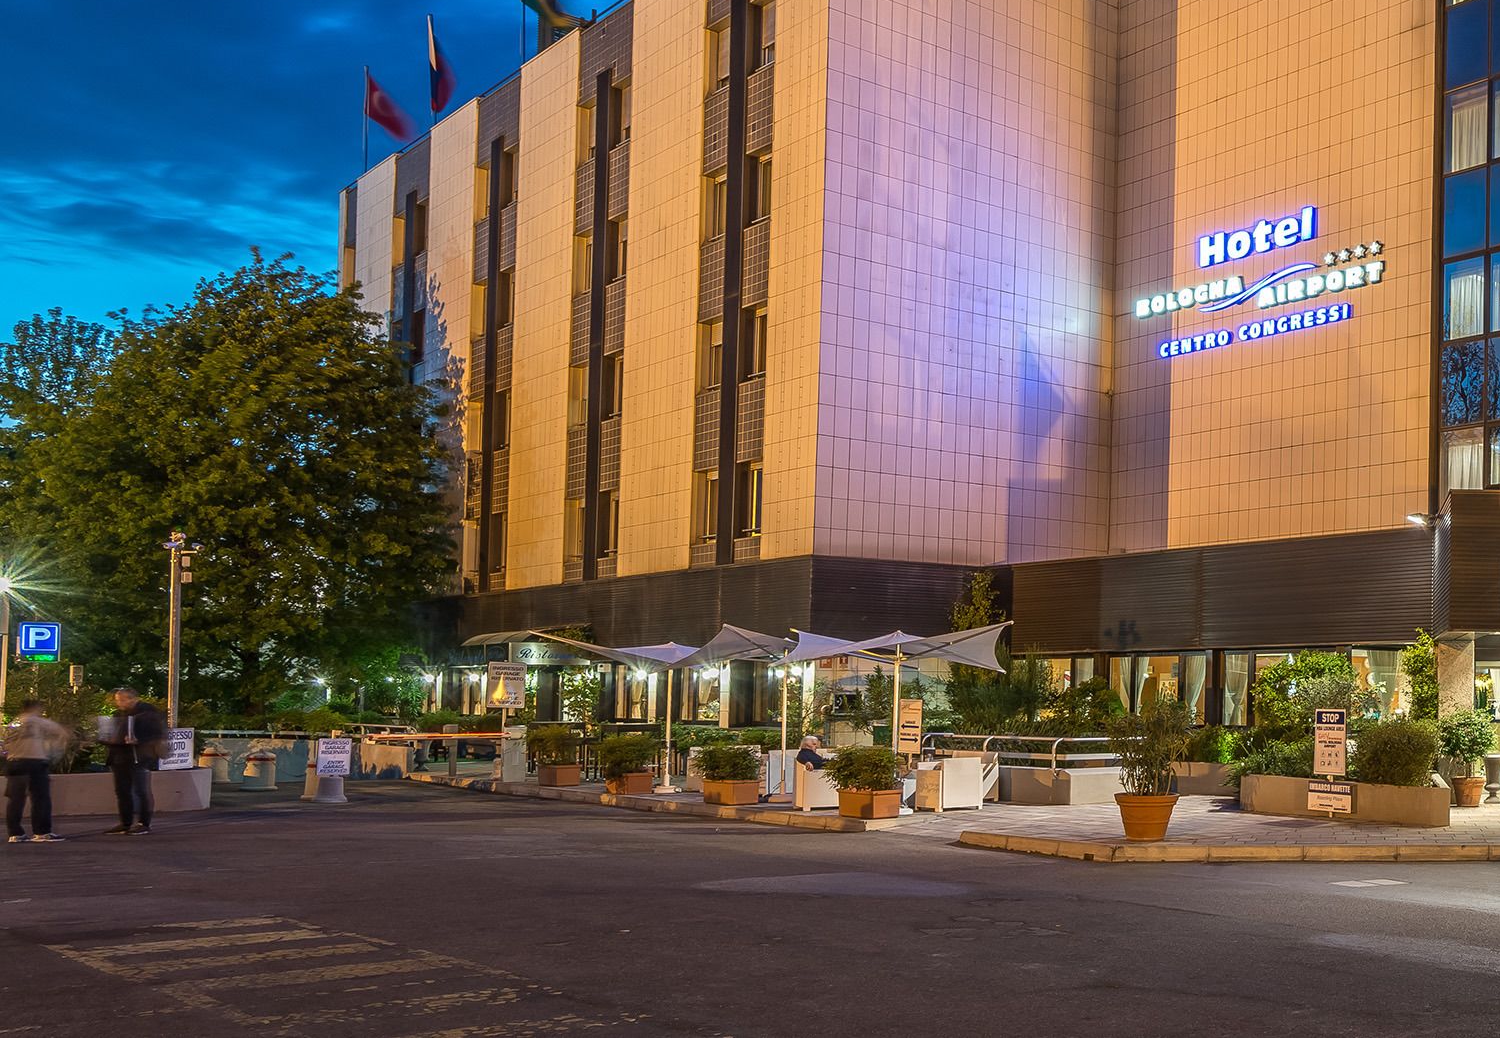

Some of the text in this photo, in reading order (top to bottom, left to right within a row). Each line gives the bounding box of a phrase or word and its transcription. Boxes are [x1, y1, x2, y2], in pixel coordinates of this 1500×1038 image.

[1199, 206, 1315, 267] Hotel
[1136, 261, 1384, 318] BOLOGNA AIRPORT
[1160, 304, 1352, 357] CENTRO CONGRESSI
[29, 627, 51, 648] P
[168, 731, 192, 739] GRESSO
[1322, 714, 1339, 723] STOP
